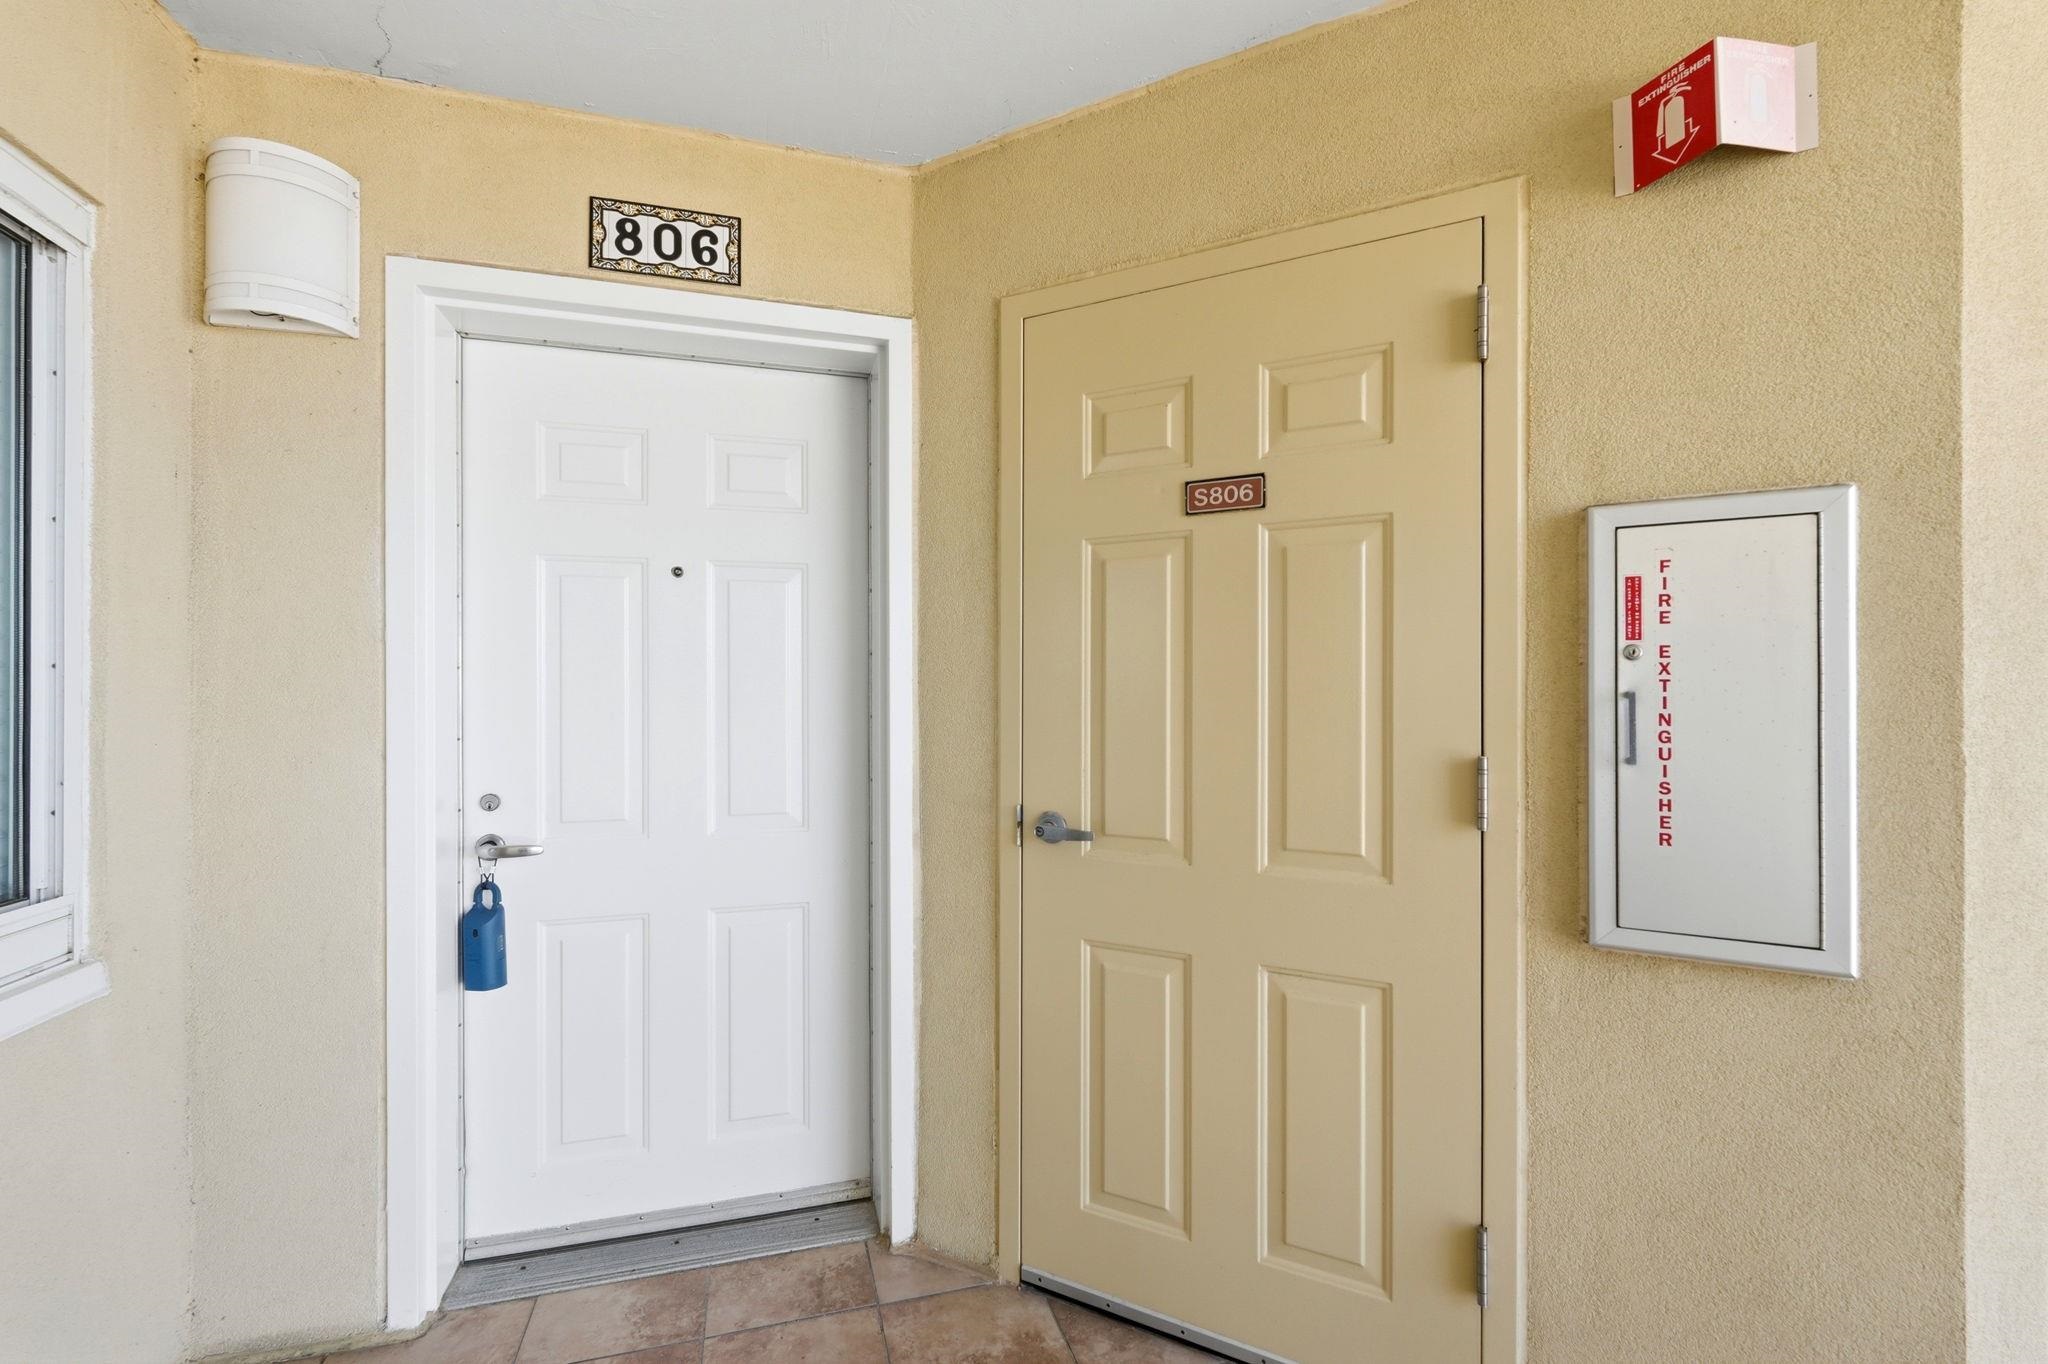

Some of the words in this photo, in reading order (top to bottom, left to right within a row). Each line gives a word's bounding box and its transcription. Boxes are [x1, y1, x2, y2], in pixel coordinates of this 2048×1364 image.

[1638, 54, 1712, 108] EXTINGUISHER
[1660, 62, 1685, 84] FIRE
[614, 217, 719, 267] 806
[1193, 483, 1254, 507] S806
[1658, 559, 1672, 624] FIRE
[1658, 645, 1673, 847] EXTINGUISHER
